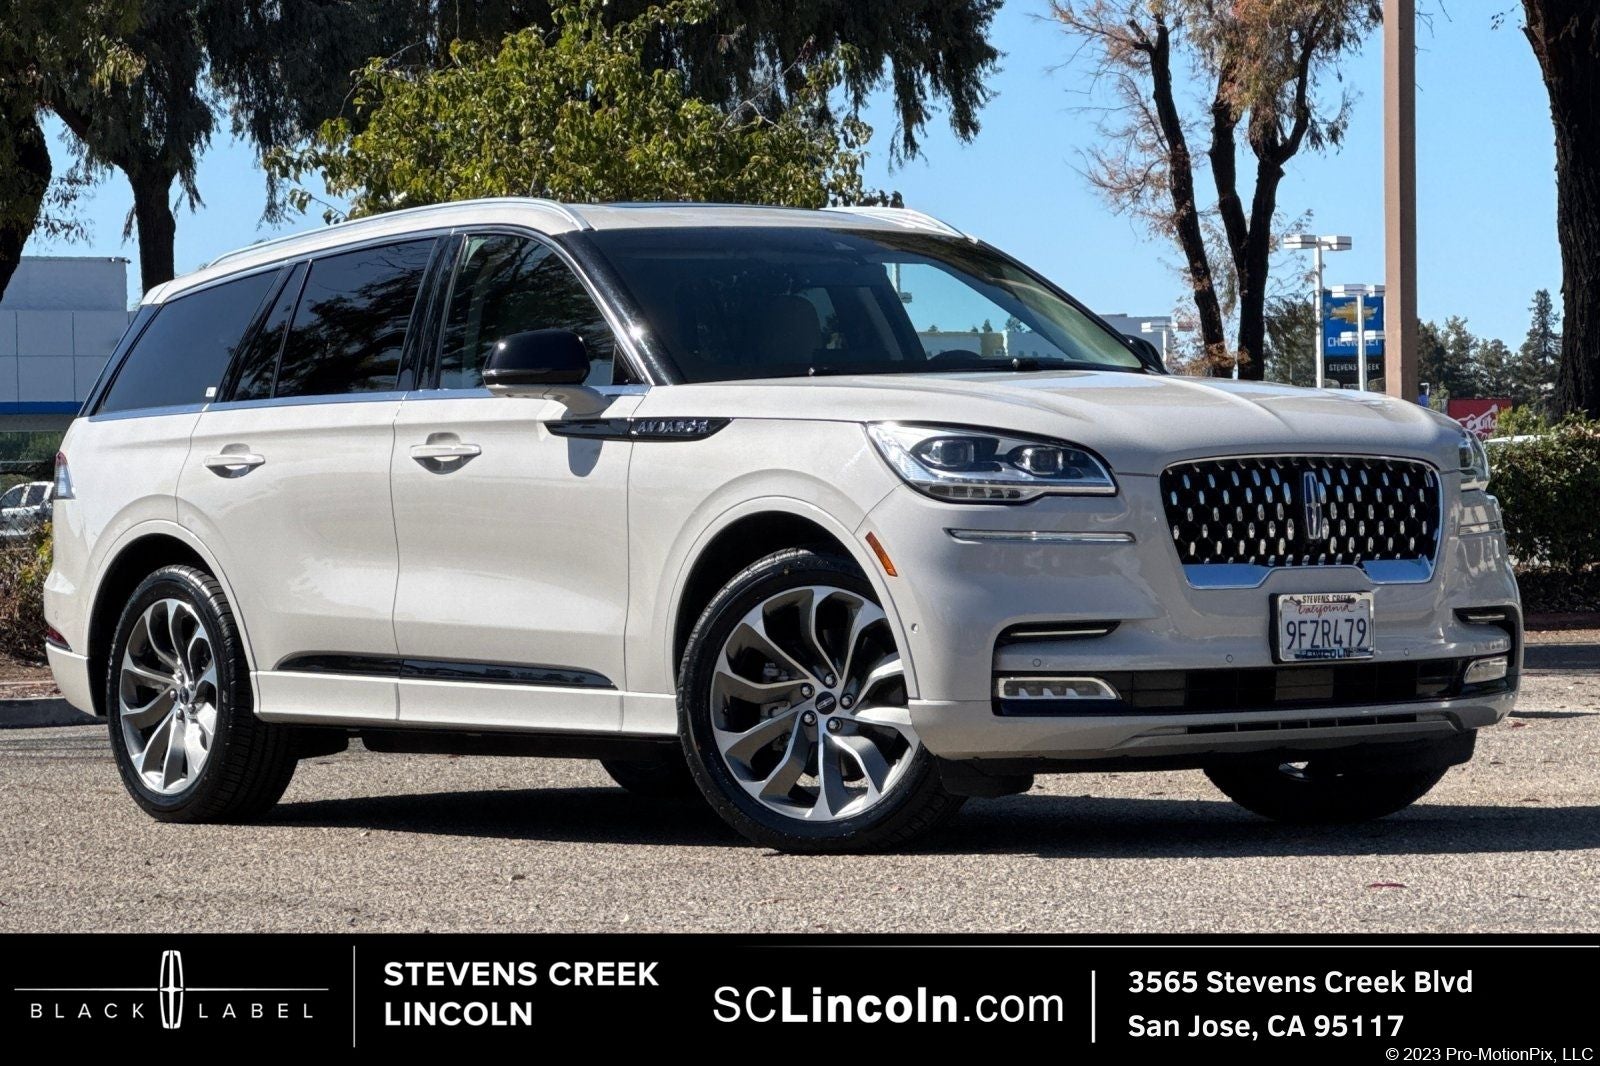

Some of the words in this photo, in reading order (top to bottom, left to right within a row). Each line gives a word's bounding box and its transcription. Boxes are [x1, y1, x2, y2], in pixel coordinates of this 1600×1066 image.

[1327, 336, 1379, 347] CHEVRET
[1328, 363, 1357, 371] STEVENS
[1302, 594, 1330, 604] STEVENS
[1298, 604, 1355, 618] California
[1286, 617, 1367, 650] 9FZR479
